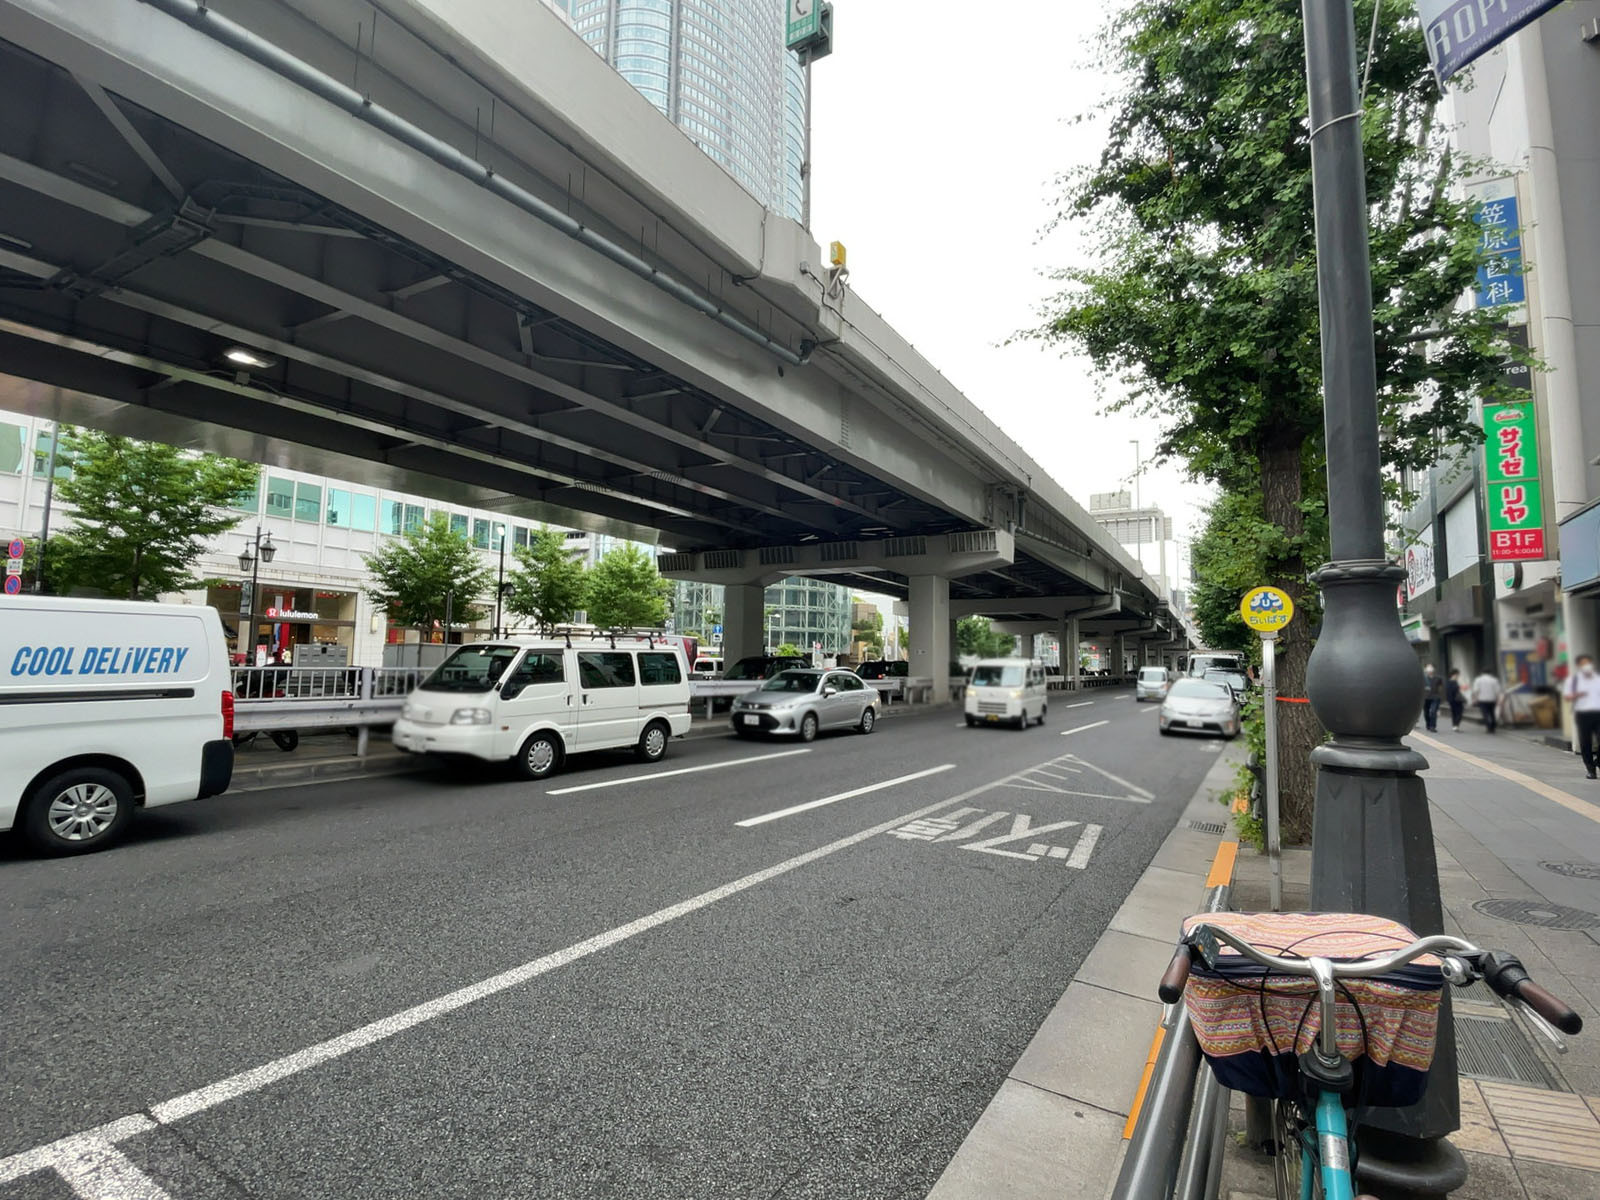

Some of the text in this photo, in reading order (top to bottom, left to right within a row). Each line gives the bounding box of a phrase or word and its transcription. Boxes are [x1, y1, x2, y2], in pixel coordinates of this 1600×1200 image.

[1498, 426, 1527, 524] サイゼリヤ
[1496, 533, 1536, 547] B1F
[280, 609, 318, 619] lululemon
[10, 646, 75, 676] COOL
